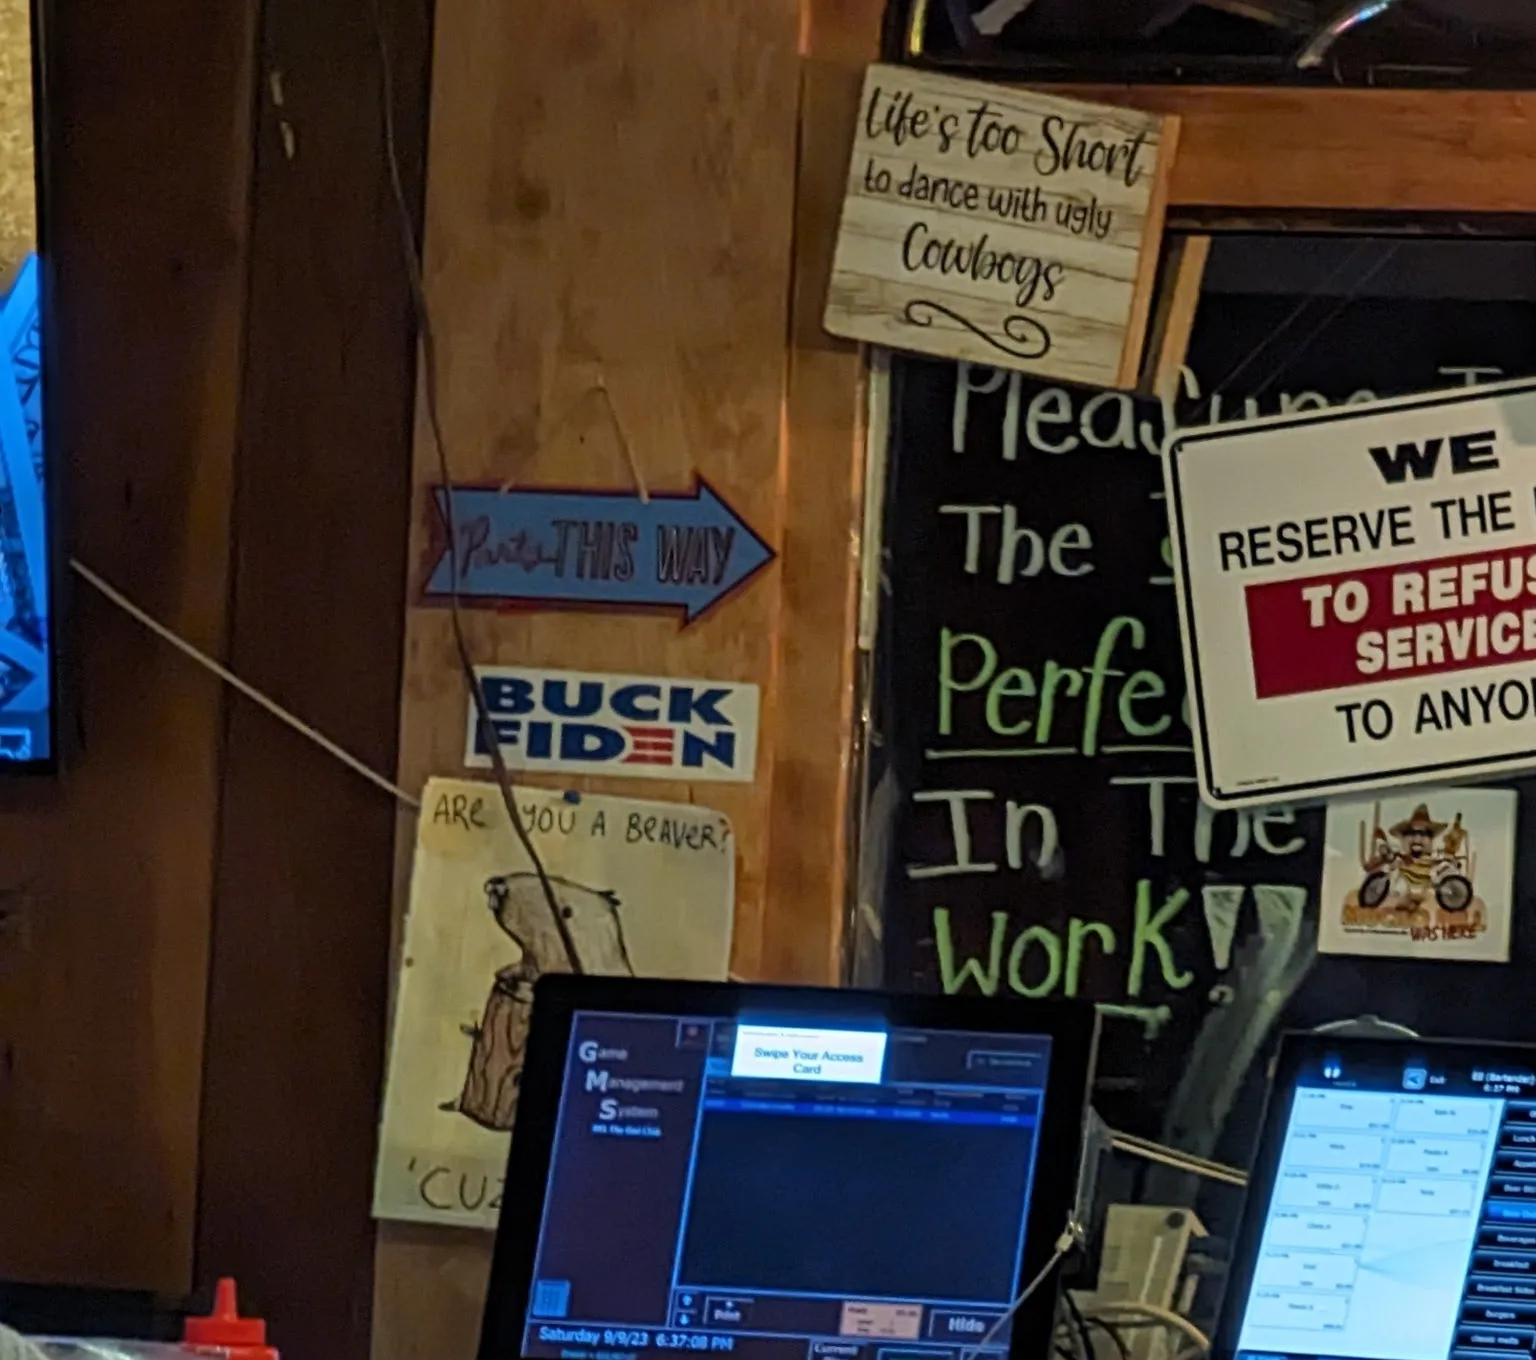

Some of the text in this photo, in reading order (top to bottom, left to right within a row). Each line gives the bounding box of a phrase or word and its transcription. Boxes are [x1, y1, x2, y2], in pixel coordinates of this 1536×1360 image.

[865, 86, 1159, 188] Life's too Short
[864, 159, 1114, 240] to dance with ugly
[902, 221, 1067, 309] Cowboys
[1368, 431, 1500, 484] WE
[552, 519, 639, 582] THIS
[656, 524, 736, 585] WAY
[939, 504, 1095, 584] The
[1219, 506, 1415, 571] RESERVE
[1430, 491, 1516, 539] THE
[1302, 581, 1369, 628] TO
[479, 677, 733, 726] BUCK
[938, 616, 1192, 756] Perfe
[474, 719, 736, 769] FIDEN
[1335, 699, 1394, 743] TO
[591, 811, 606, 836] A
[908, 789, 1060, 880] In
[754, 1047, 863, 1063] Swipe Your Access
[793, 1063, 822, 1074] Card
[539, 1326, 600, 1347] Saturday
[711, 1337, 734, 1351] PM
[948, 1317, 985, 1333] Hide
